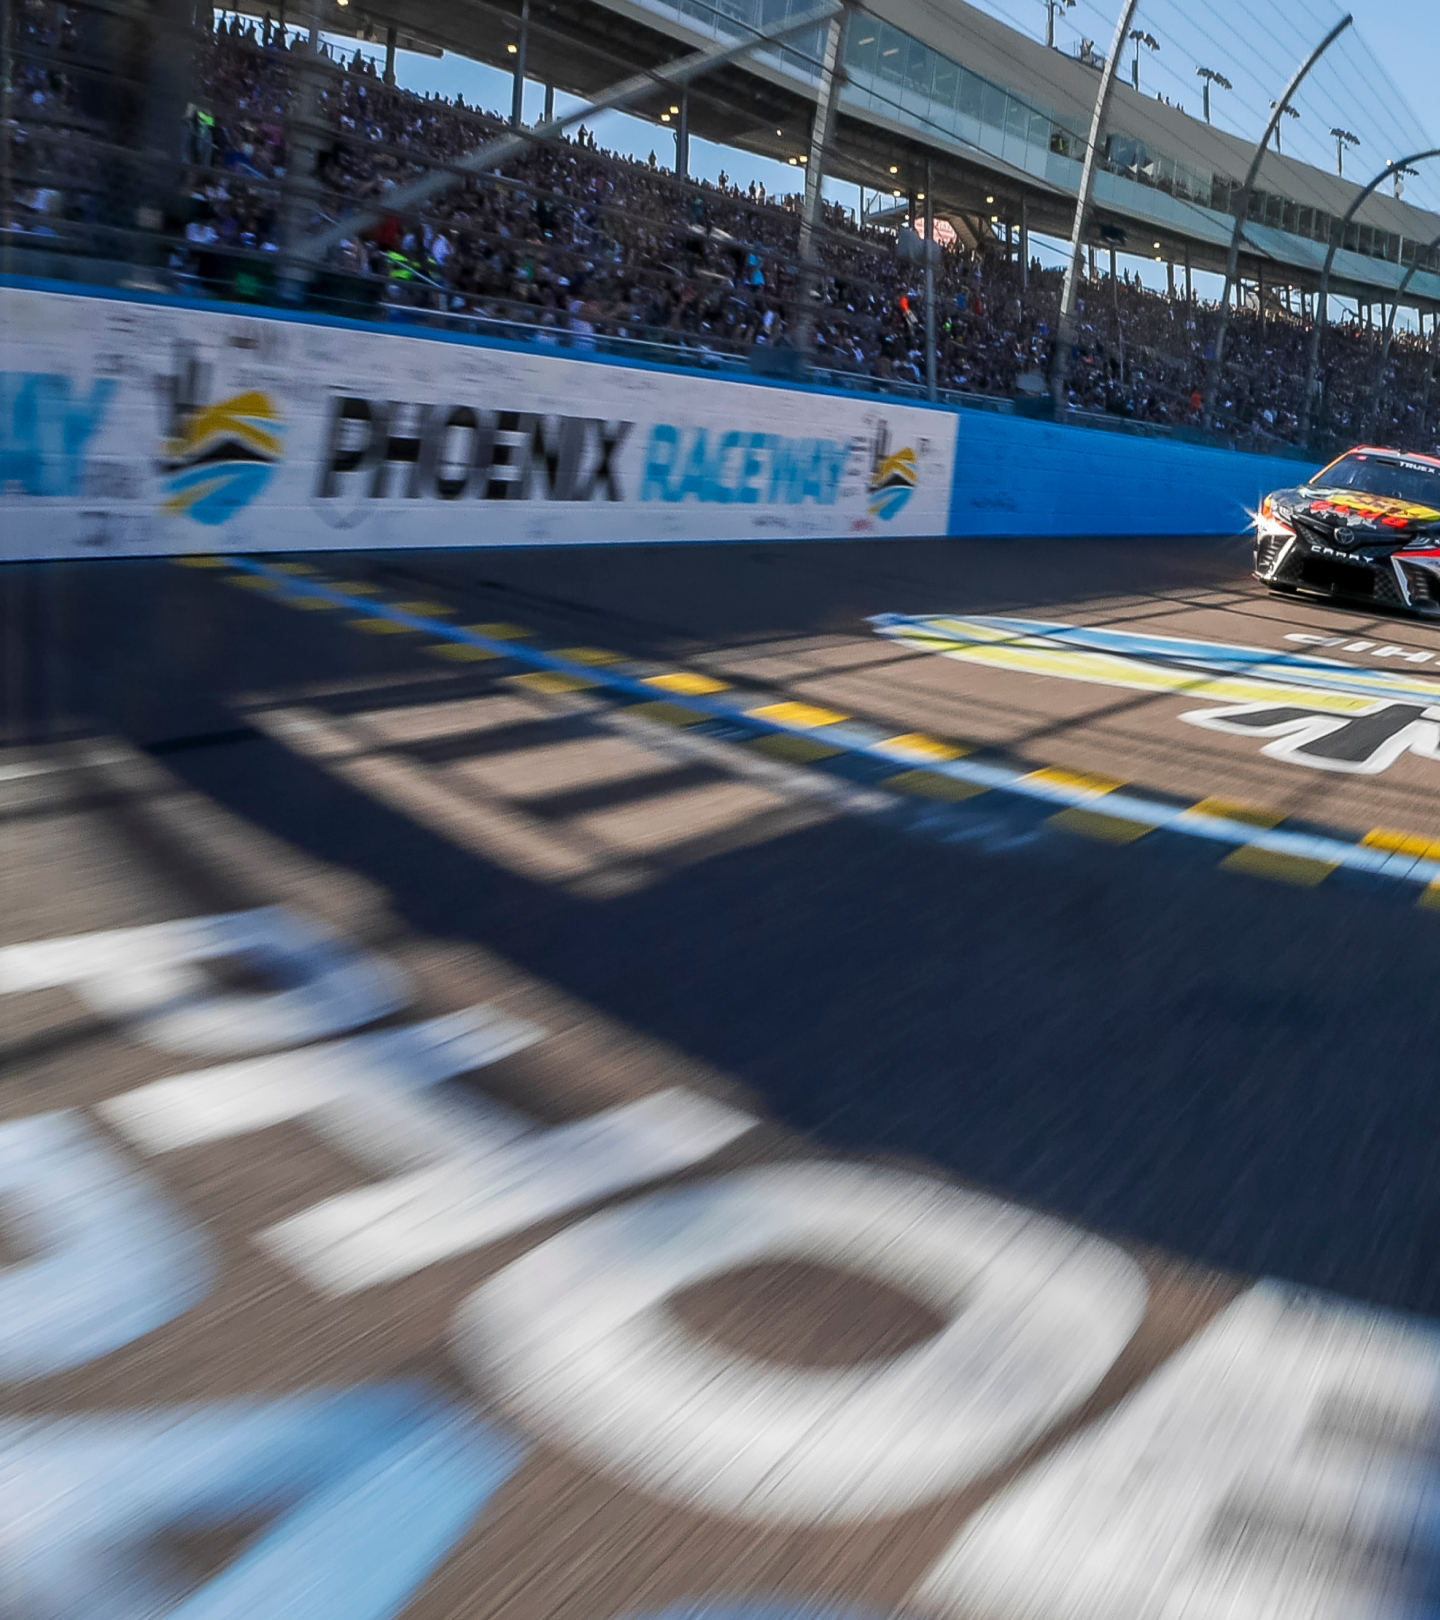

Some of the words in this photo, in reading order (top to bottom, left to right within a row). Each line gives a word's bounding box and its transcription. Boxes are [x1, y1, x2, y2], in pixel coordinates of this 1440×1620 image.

[316, 395, 636, 502] PHOENIX
[640, 423, 852, 506] RACEWAY
[1399, 461, 1435, 474] TRUEX
[1310, 545, 1374, 563] CAMRY
